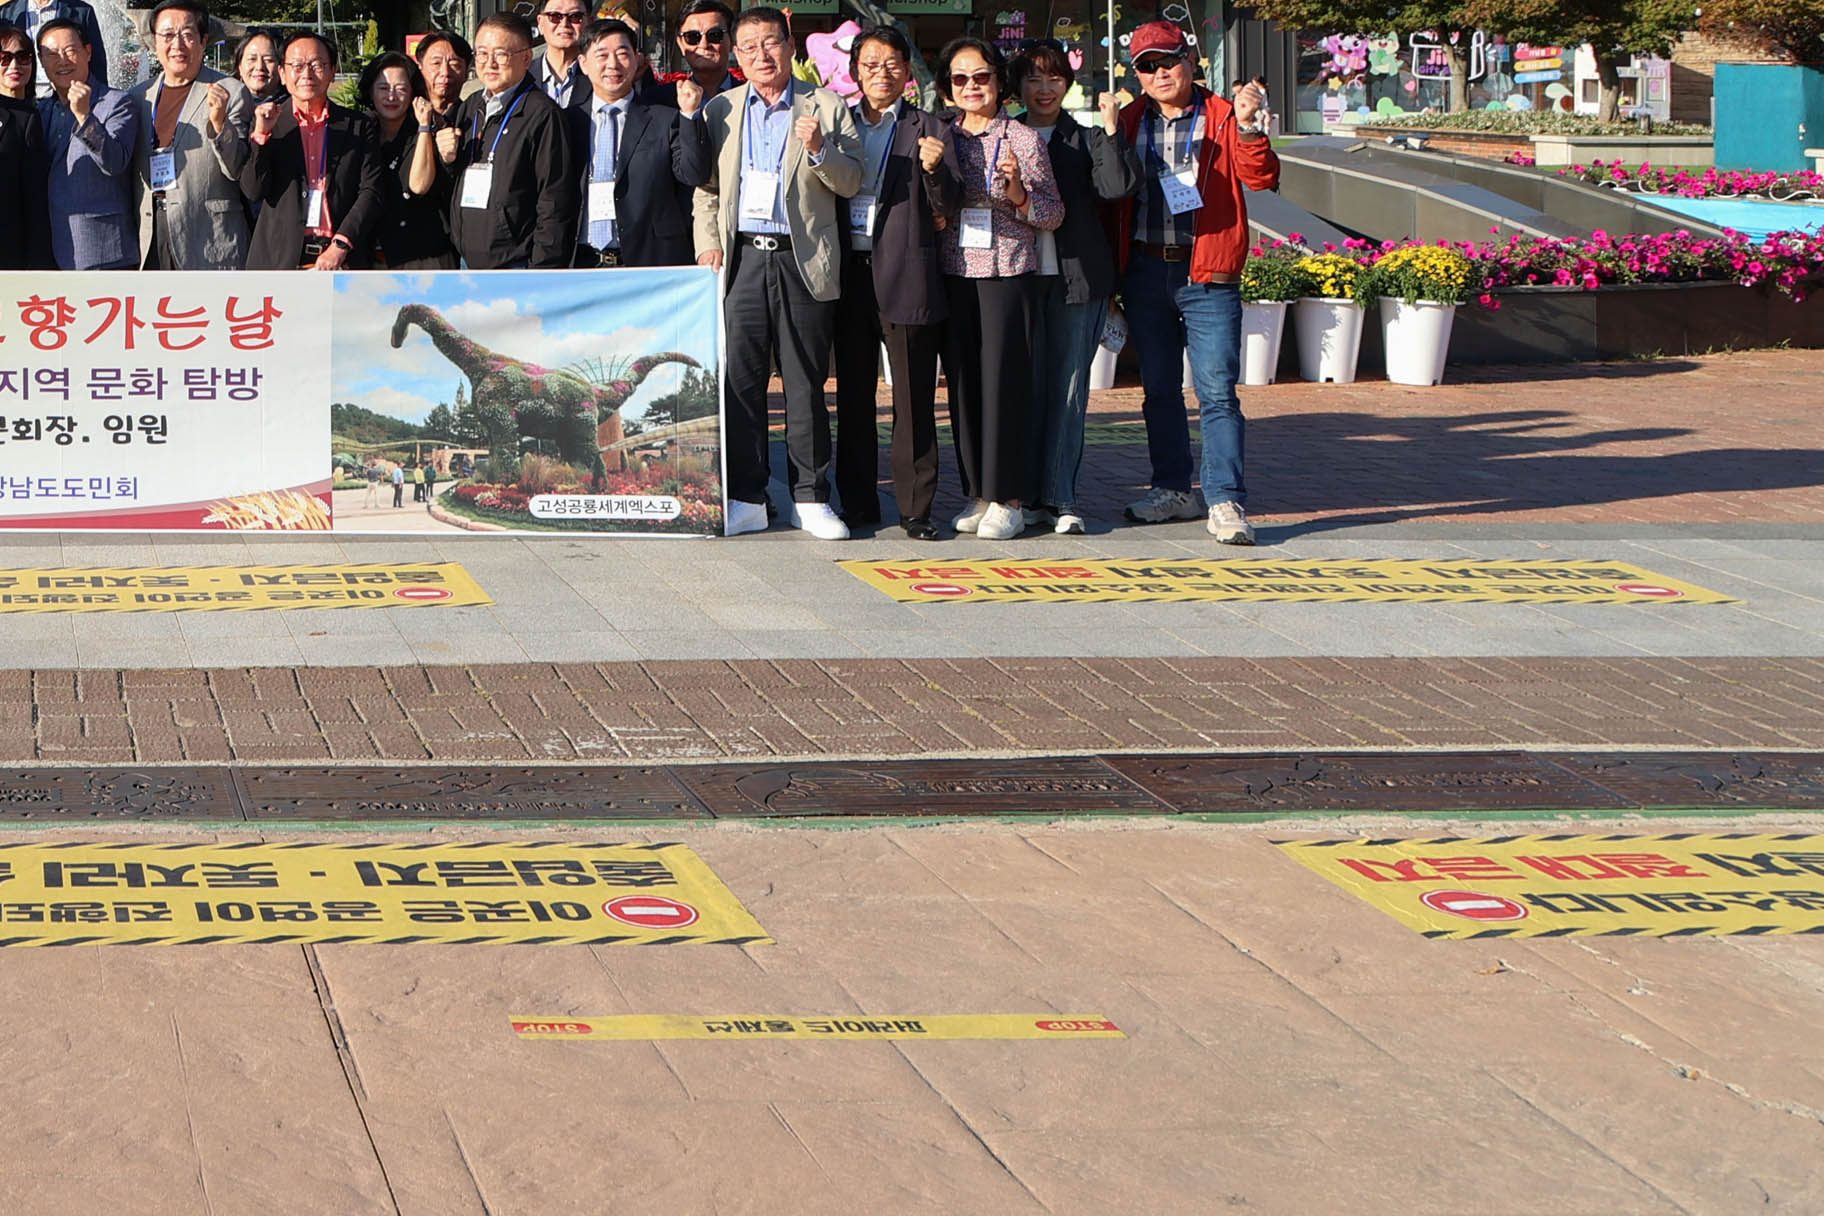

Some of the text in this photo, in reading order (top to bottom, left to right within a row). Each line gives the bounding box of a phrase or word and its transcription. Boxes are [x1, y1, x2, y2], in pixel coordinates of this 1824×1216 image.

[86, 367, 169, 401] 문화
[183, 367, 264, 401] 탐방
[103, 414, 168, 445] 임원
[538, 498, 674, 515] 고성공룡세계엑스포
[43, 861, 278, 889] 돗자리
[353, 859, 677, 888] 출입금지
[1337, 856, 1527, 883] 금지
[1516, 853, 1709, 881] 절대
[196, 899, 382, 924] 공연이
[401, 898, 592, 923] 이곳은
[802, 1020, 928, 1033] 퍼레이드
